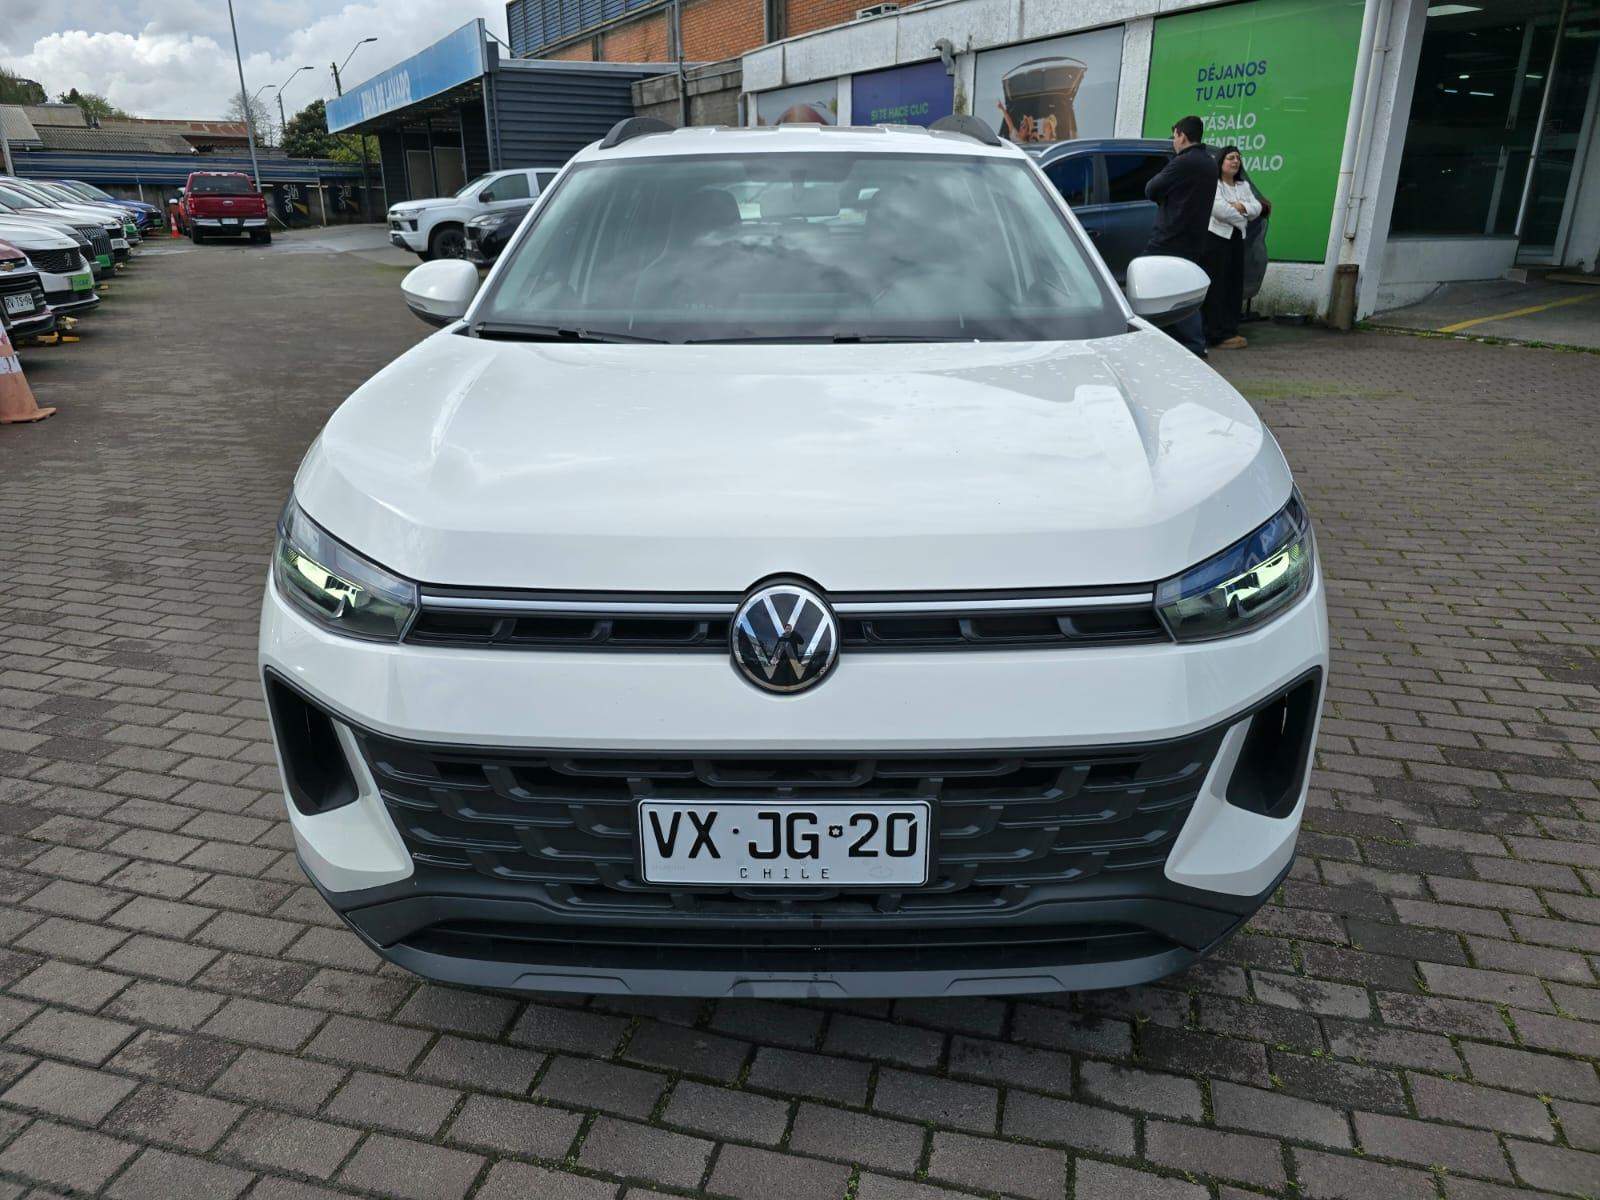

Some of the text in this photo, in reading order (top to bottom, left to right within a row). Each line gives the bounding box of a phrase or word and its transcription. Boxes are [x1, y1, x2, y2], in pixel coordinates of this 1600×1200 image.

[1197, 60, 1267, 82] DÉJANOS
[1195, 82, 1257, 102] TU AUTO
[888, 105, 909, 118] HACE
[910, 102, 929, 116] CLIC
[1202, 133, 1267, 151] ÉNDELO
[1242, 154, 1284, 172] VALO
[739, 868, 830, 879] CHILE
